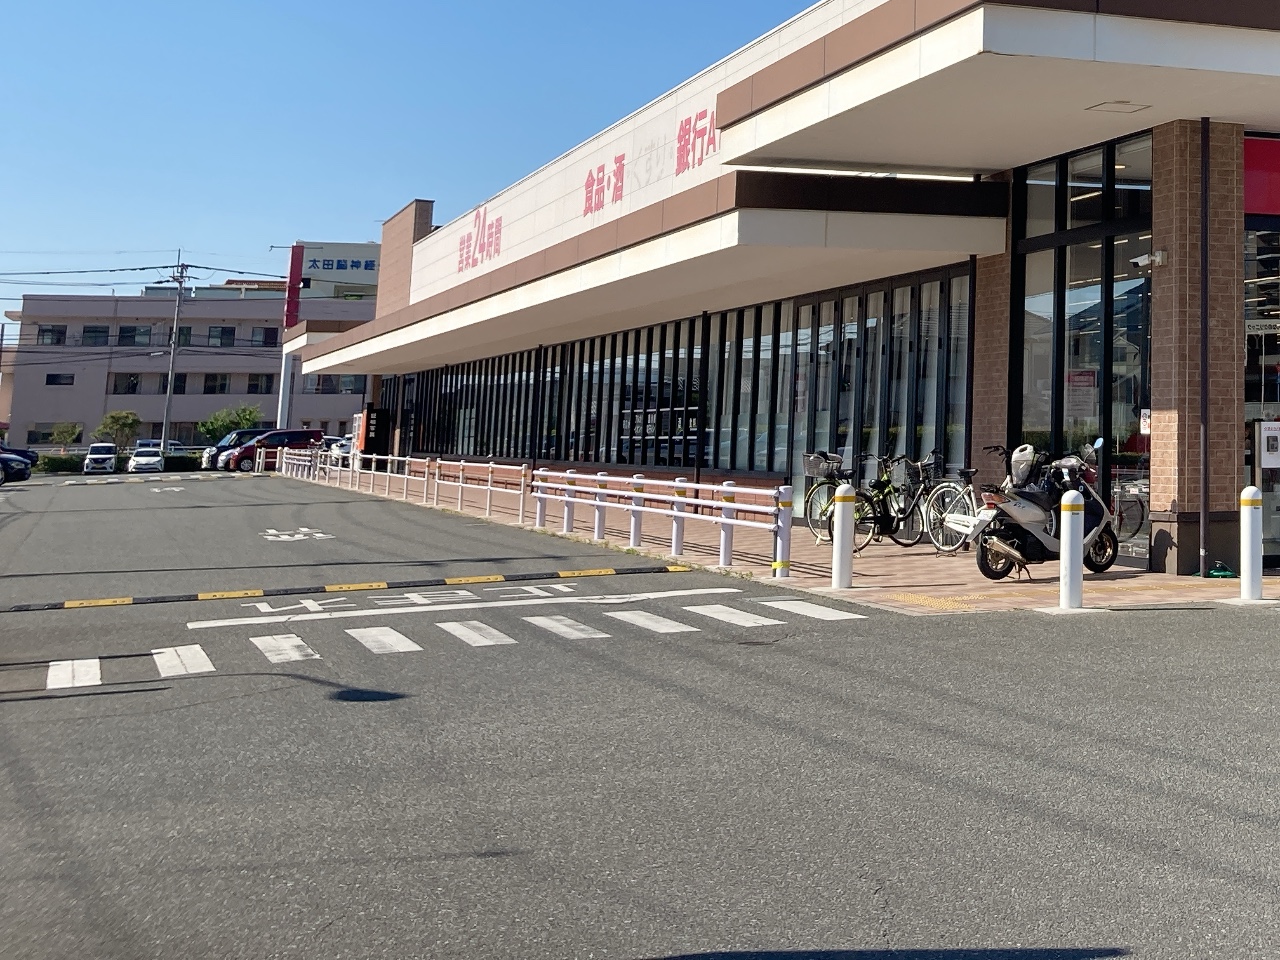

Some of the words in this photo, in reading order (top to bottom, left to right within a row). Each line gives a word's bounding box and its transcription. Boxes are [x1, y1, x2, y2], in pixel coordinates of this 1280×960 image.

[583, 153, 625, 217] 食品・酒
[458, 206, 503, 273] 営業24時間
